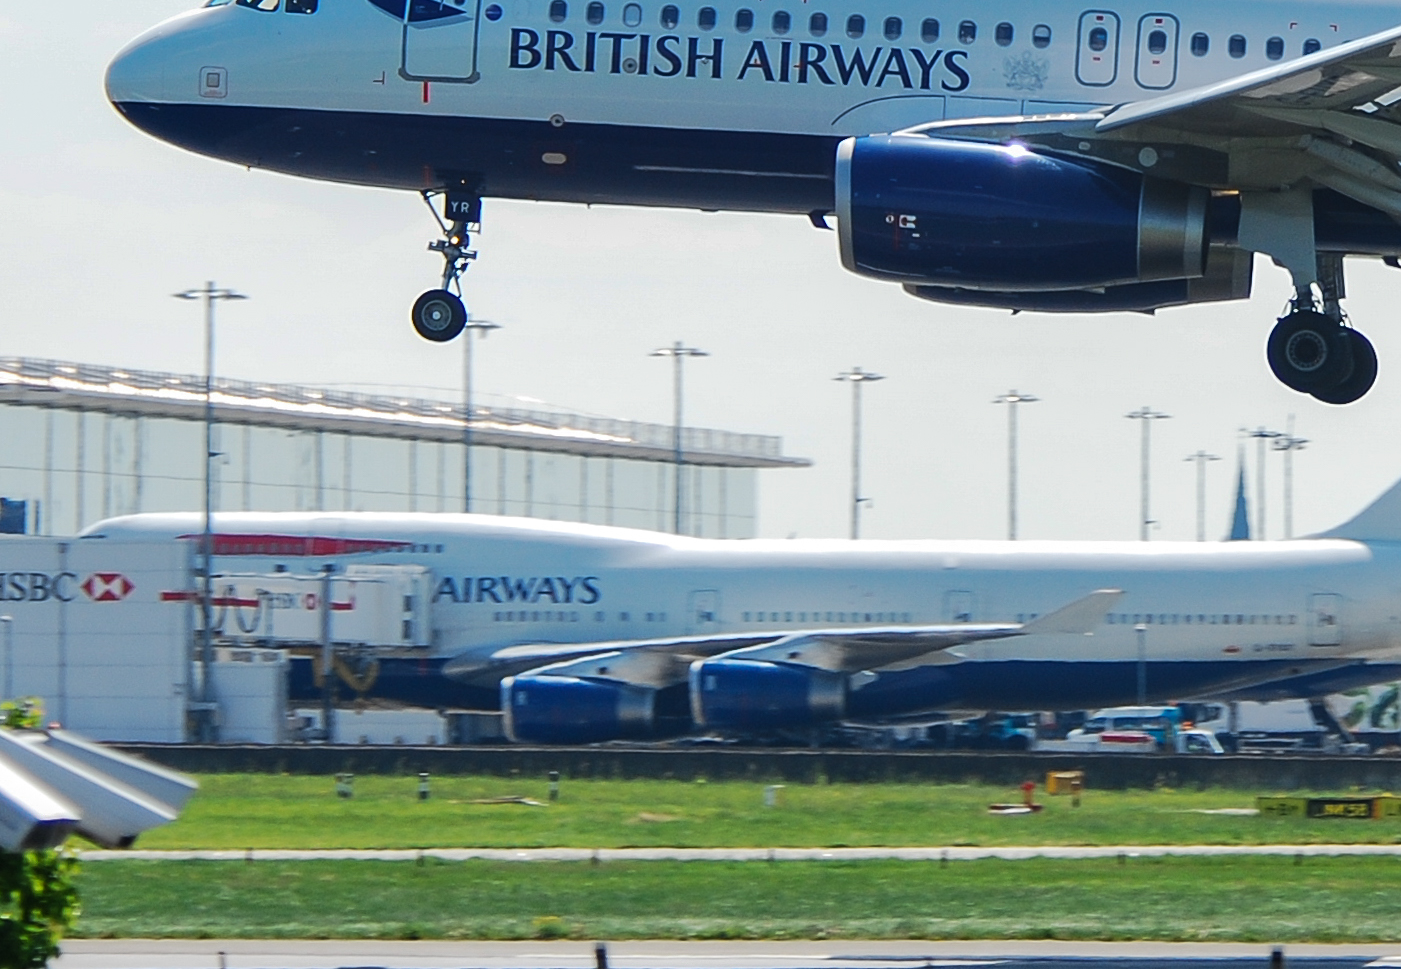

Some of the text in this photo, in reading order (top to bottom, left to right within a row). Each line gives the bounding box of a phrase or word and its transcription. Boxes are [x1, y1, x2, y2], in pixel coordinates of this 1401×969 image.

[508, 27, 971, 92] BRITISH AIRWAYS
[450, 200, 470, 214] YR
[431, 576, 601, 605] AIRWAYS
